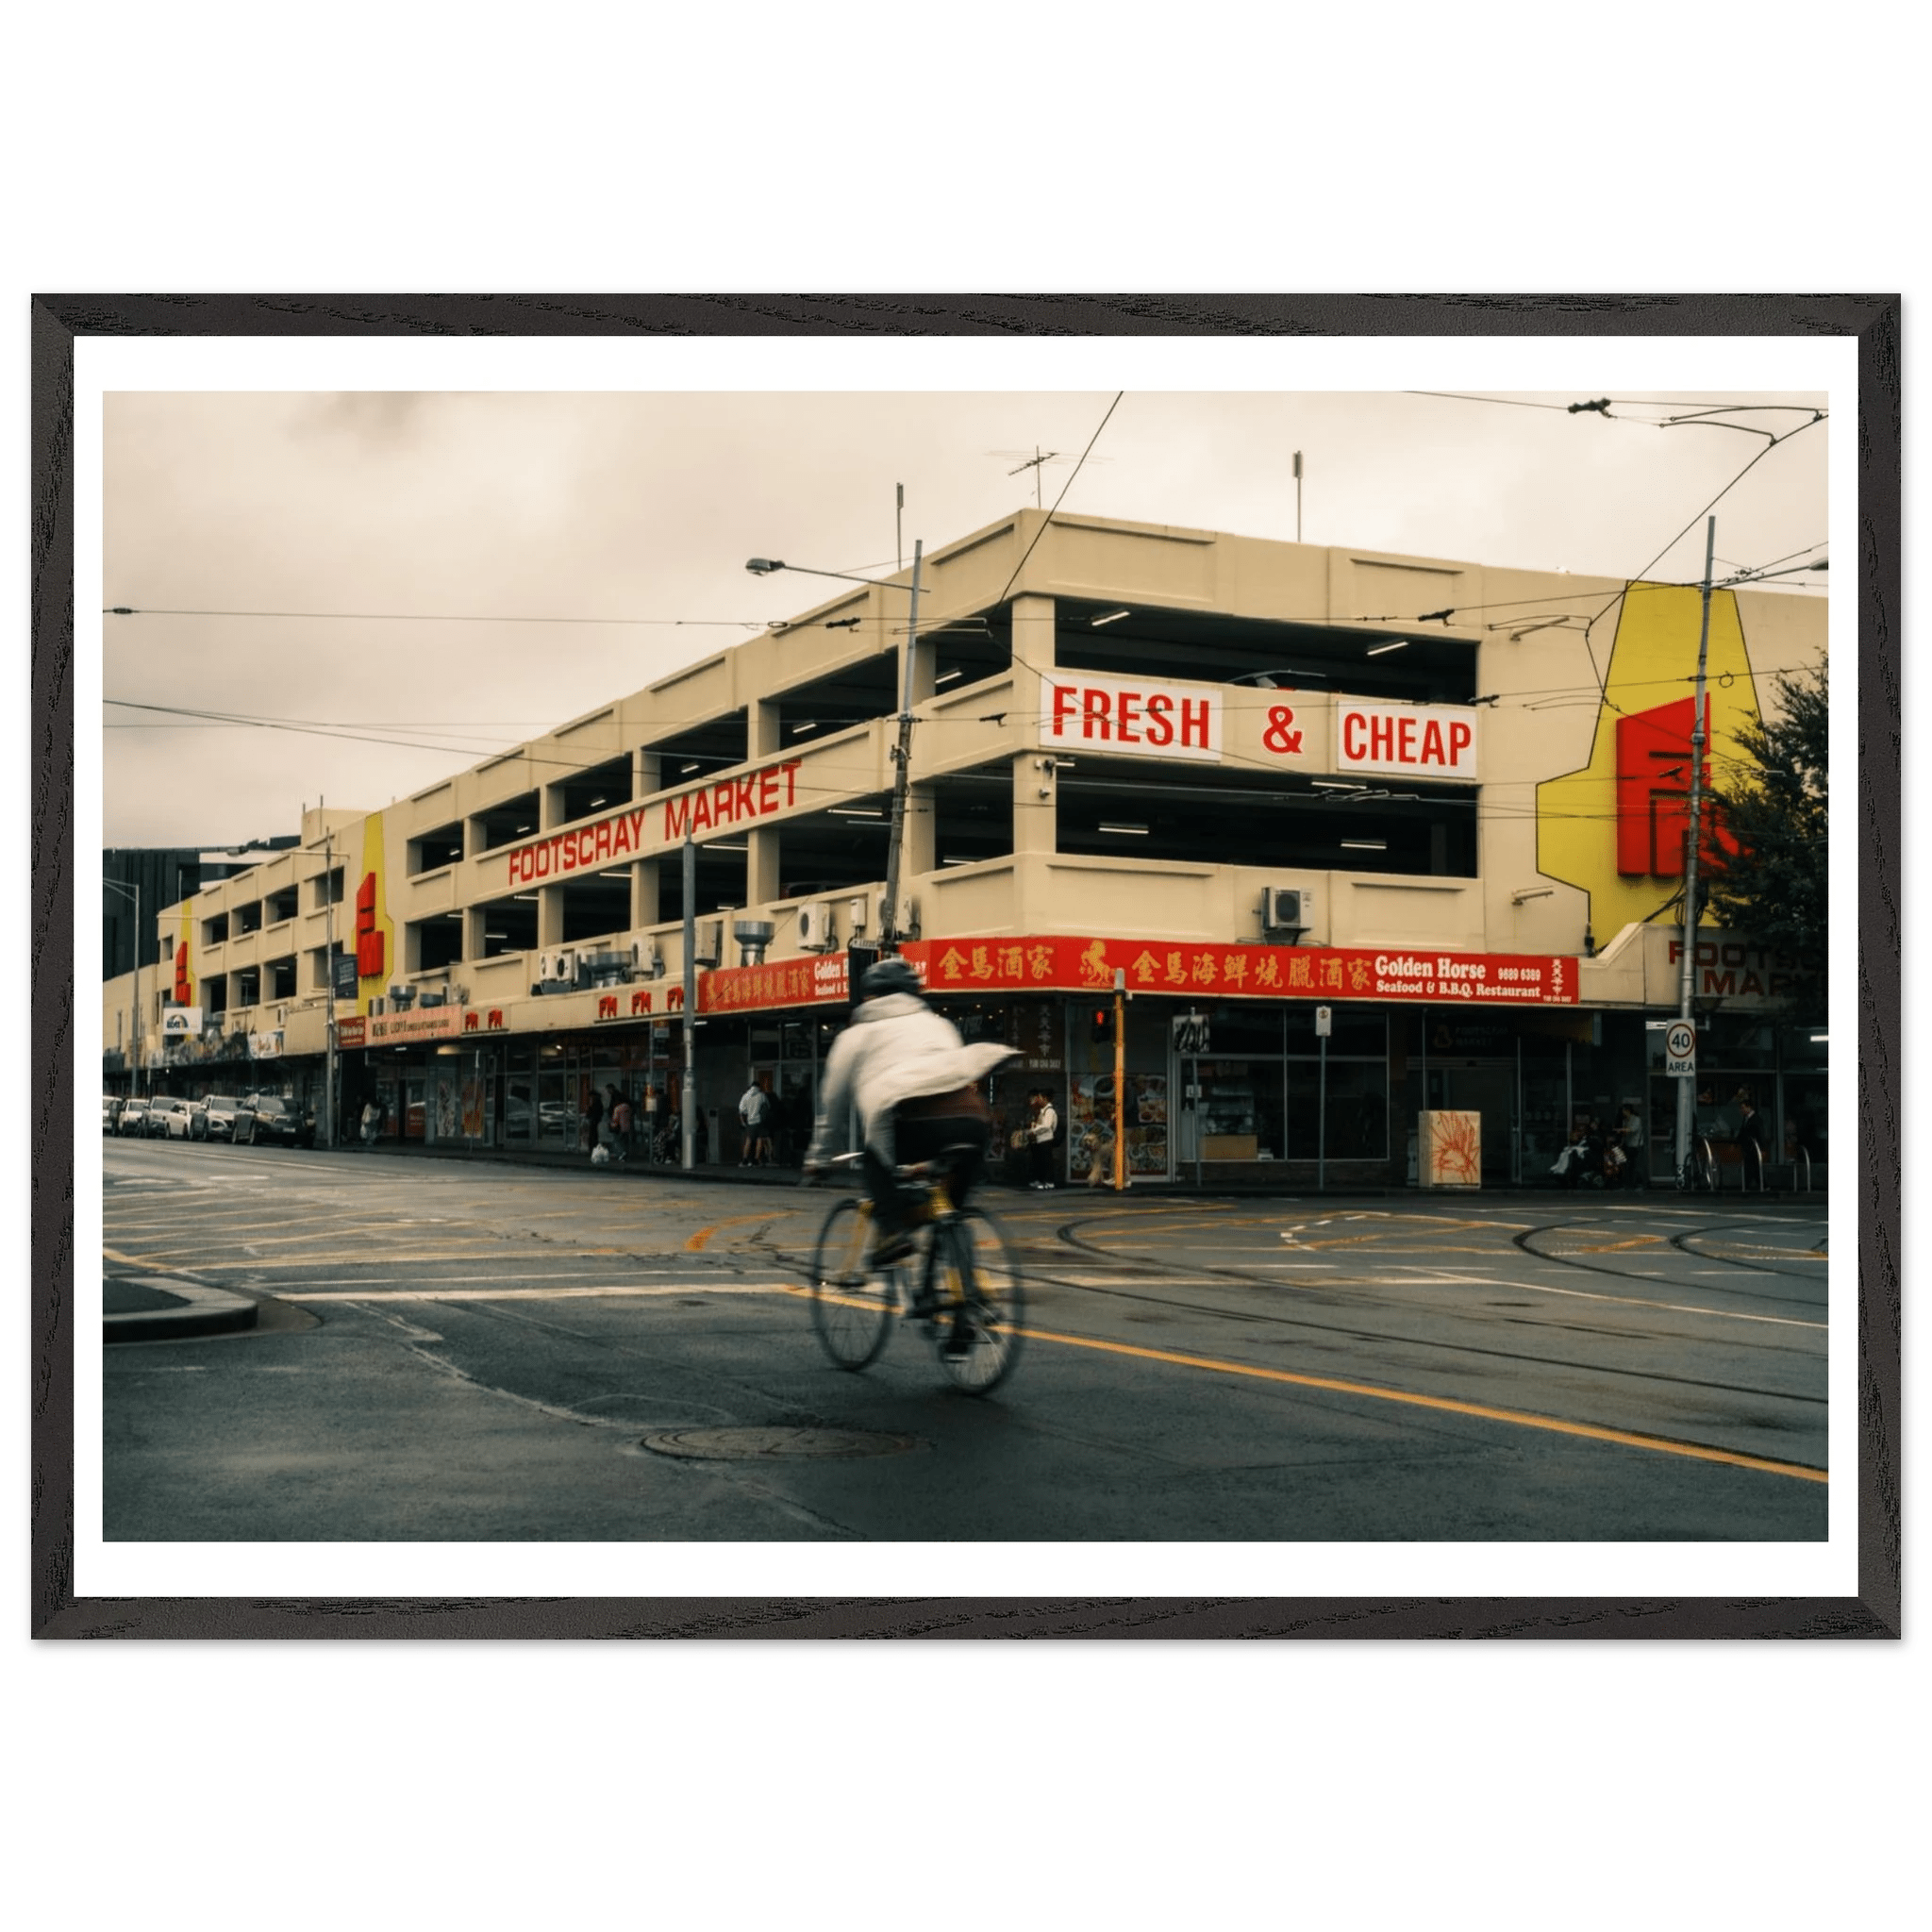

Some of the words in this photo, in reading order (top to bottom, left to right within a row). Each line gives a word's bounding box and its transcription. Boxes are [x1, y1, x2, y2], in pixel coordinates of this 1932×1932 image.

[1053, 686, 1209, 748] FRESH
[1262, 705, 1303, 755] &
[1343, 712, 1472, 766] CHEAP
[508, 808, 645, 886] FOOTSCRAY
[664, 758, 802, 841] MARKET
[814, 960, 841, 980] Golden
[939, 944, 1054, 980] 金馬酒家
[1375, 955, 1433, 977] Golden
[1437, 957, 1487, 979] Horse
[1376, 979, 1423, 993] Seafood
[1475, 983, 1541, 997] Restaurant
[1672, 1033, 1690, 1049] 40
[1668, 1061, 1694, 1073] AREA
